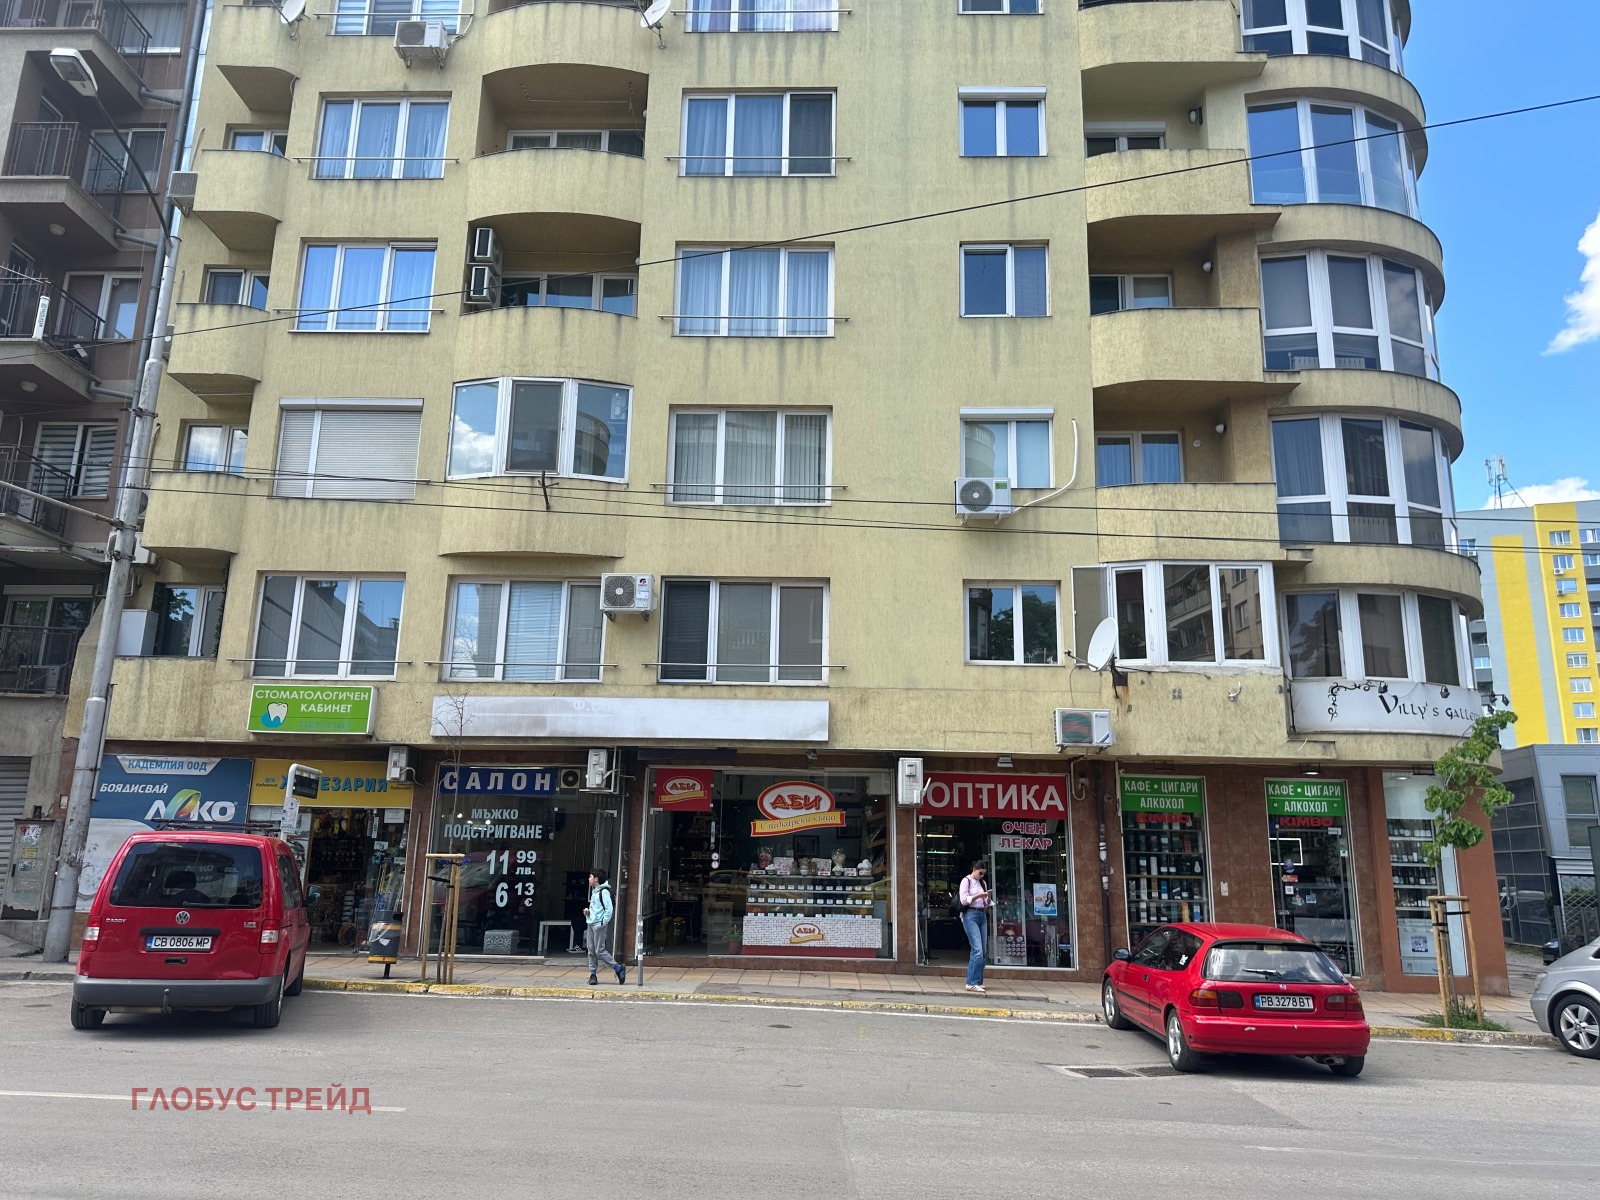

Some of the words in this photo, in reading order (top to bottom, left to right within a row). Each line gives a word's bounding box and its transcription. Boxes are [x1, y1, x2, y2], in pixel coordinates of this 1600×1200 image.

[255, 689, 369, 701] СТОМАТОЛОГИЧЕН
[300, 703, 352, 713] КАБИНЕТ
[128, 759, 183, 770] КАДЕМЛИЯ
[187, 761, 207, 772] ООД
[279, 775, 388, 793] ЕЗАРИЯ
[443, 771, 551, 791] САЛОН
[670, 782, 697, 791] АБИ
[1124, 780, 1151, 792] КАФЕ
[1160, 782, 1198, 794] ЦИГАРИ
[99, 783, 169, 794] БОЯДИСВАЙ
[1268, 784, 1295, 796] КАФЕ
[1304, 785, 1341, 797] ЦИГАРИ
[770, 793, 823, 811] АБИ
[926, 781, 1065, 812] ОПТИКА
[1140, 797, 1185, 809] АЛКОХОЛ
[1283, 801, 1328, 813] АЛКОХОЛ
[471, 808, 519, 820] МЪЖКО
[1135, 813, 1190, 824] KIMBO
[1001, 821, 1047, 835] ОЧЕН
[1280, 817, 1334, 827] KIMBO
[443, 824, 543, 840] ПОДСТРИГВАНЕ
[999, 837, 1053, 850] ЛЕКАР
[486, 850, 509, 875] 11
[516, 850, 537, 864] 99
[515, 867, 536, 876] лв.
[495, 882, 509, 908] 6
[514, 882, 535, 896] 13
[153, 937, 168, 947] CB
[169, 938, 194, 948] 0806
[196, 938, 210, 948] MP
[1261, 996, 1274, 1006] PB
[1275, 996, 1298, 1007] 3278
[1299, 996, 1311, 1007] BT
